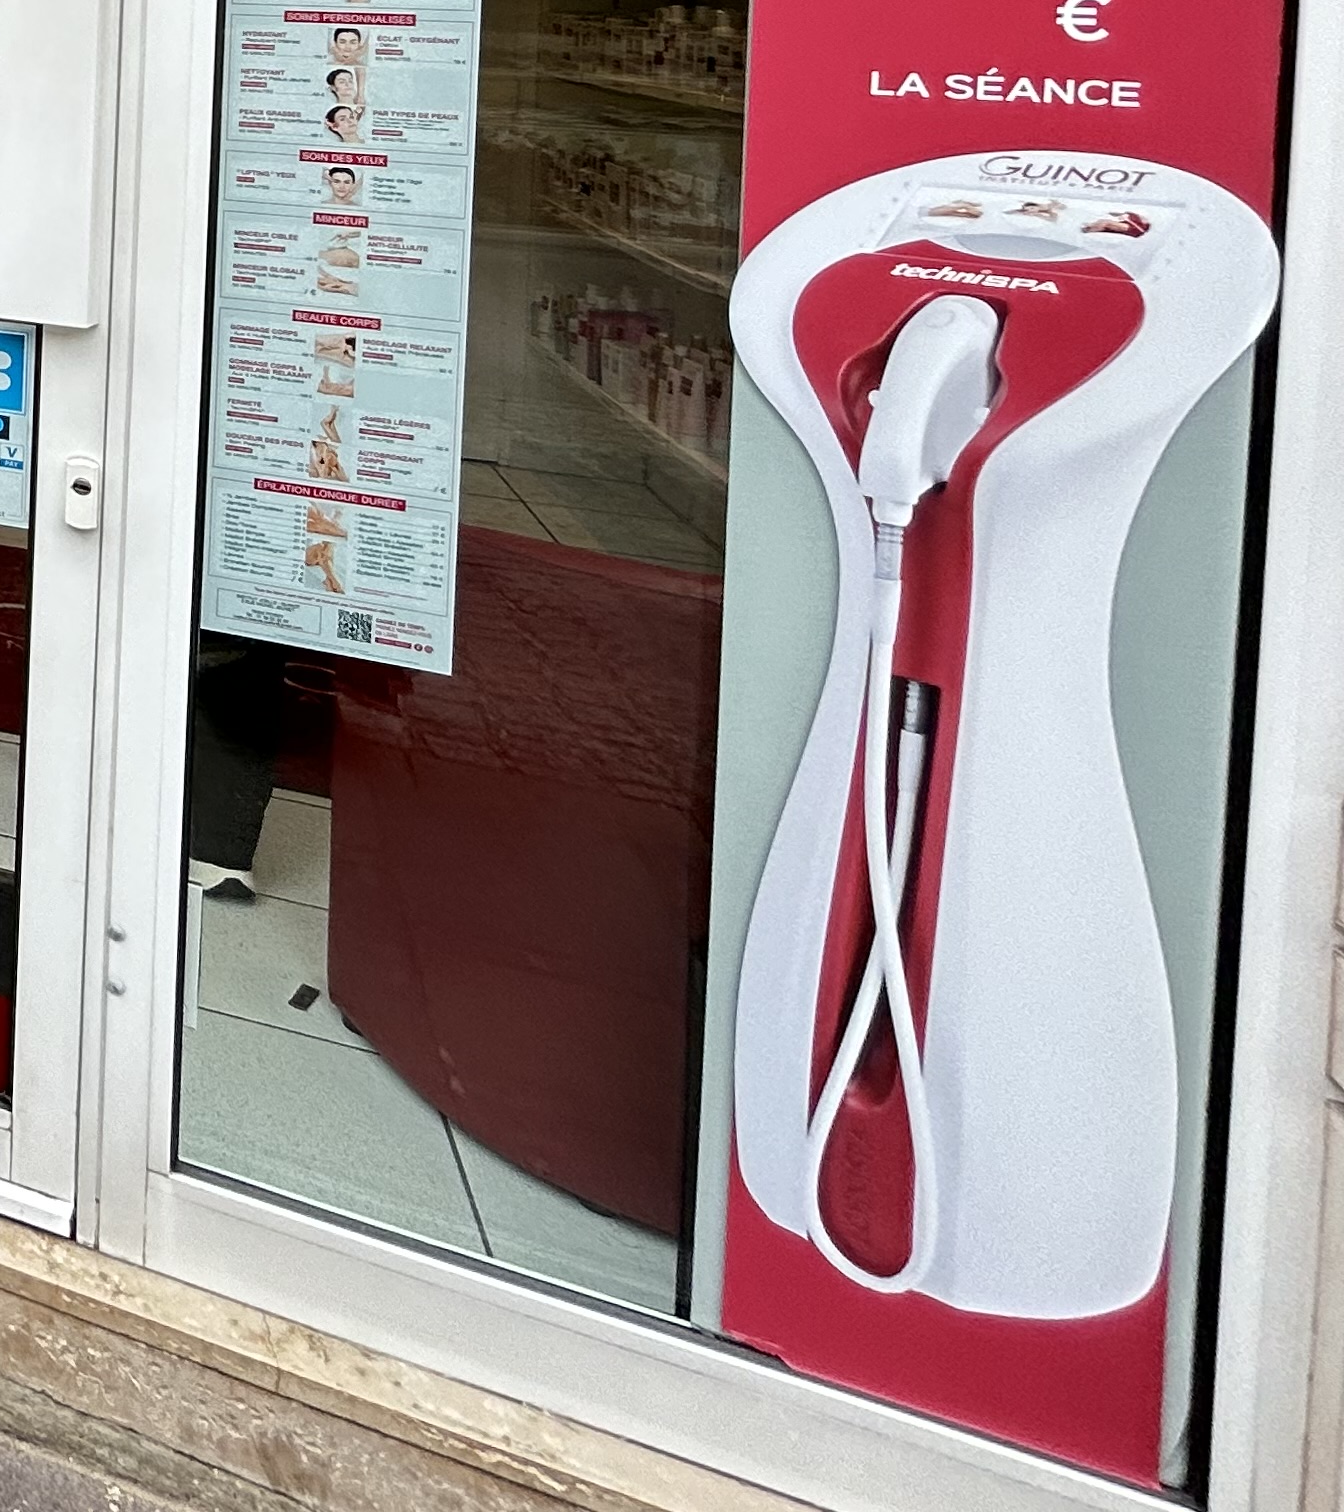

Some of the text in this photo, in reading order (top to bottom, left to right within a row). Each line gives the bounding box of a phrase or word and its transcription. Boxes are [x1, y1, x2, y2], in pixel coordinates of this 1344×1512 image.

[869, 67, 1142, 108] LA SÉANCE
[331, 153, 354, 164] DES
[979, 155, 1156, 188] GUINOT
[339, 316, 380, 329] CORPS
